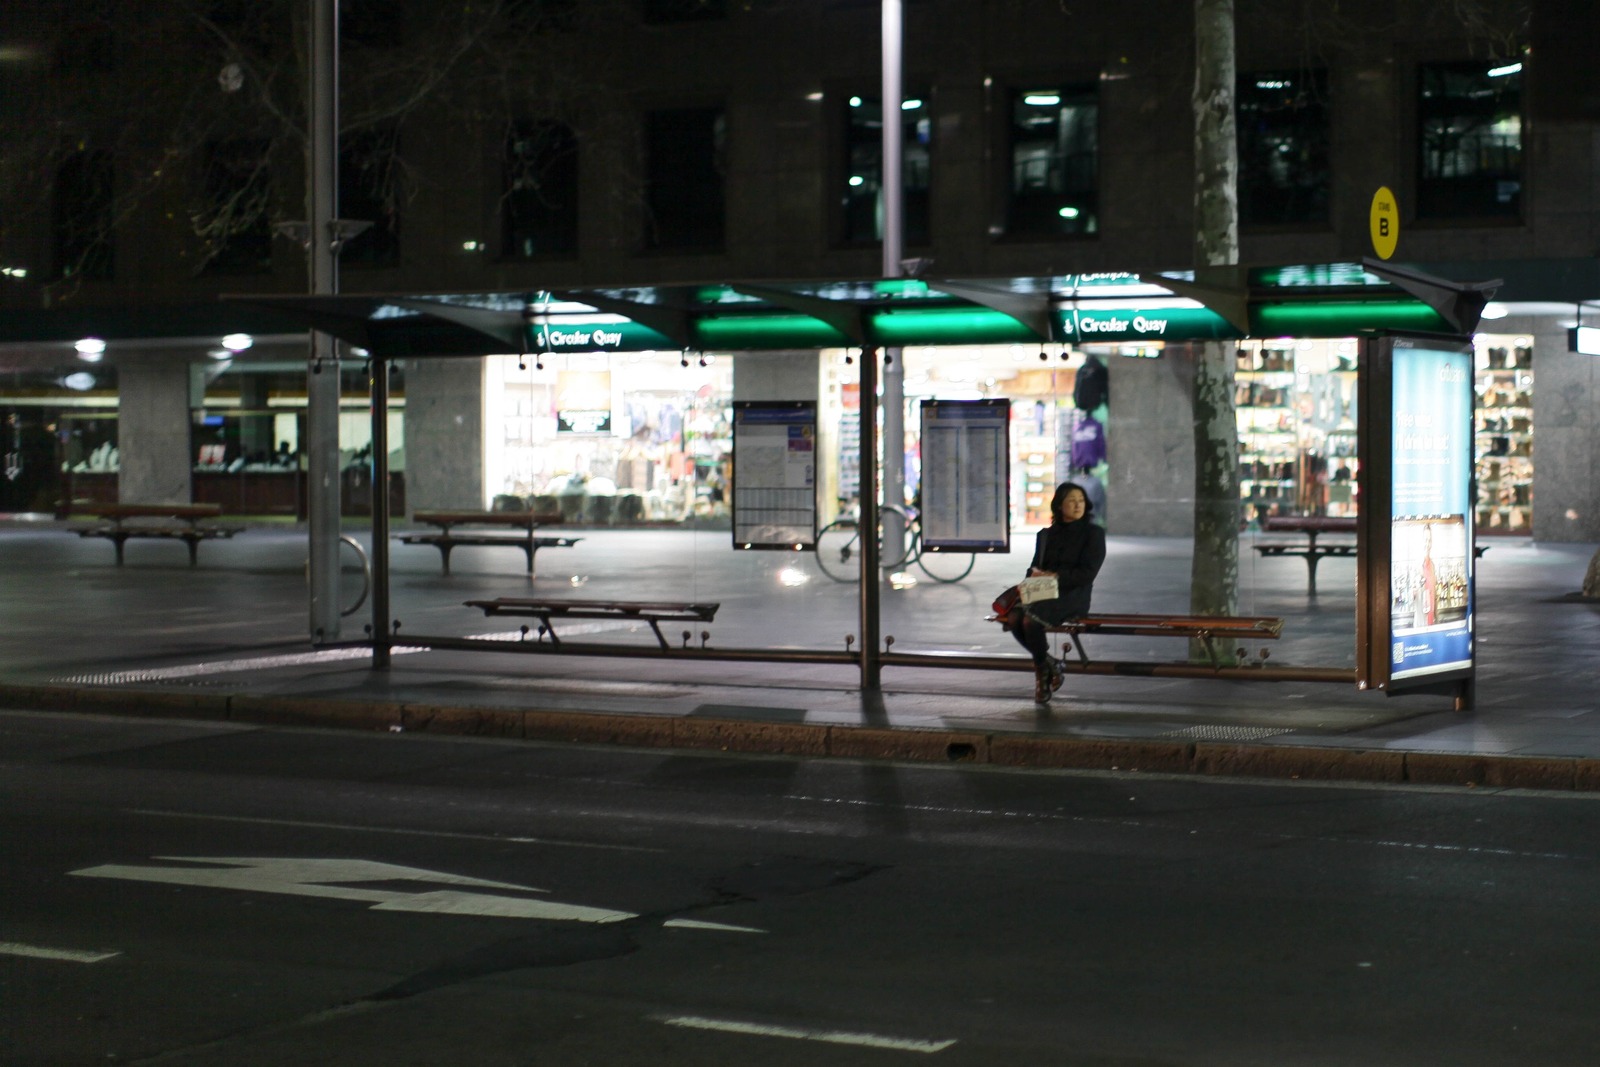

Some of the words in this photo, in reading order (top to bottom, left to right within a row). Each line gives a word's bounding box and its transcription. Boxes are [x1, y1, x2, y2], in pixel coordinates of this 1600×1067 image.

[1380, 217, 1389, 237] B
[1080, 316, 1130, 333] Circular
[1132, 316, 1168, 334] Quay
[549, 330, 591, 346] Circular
[592, 329, 622, 347] Quay
